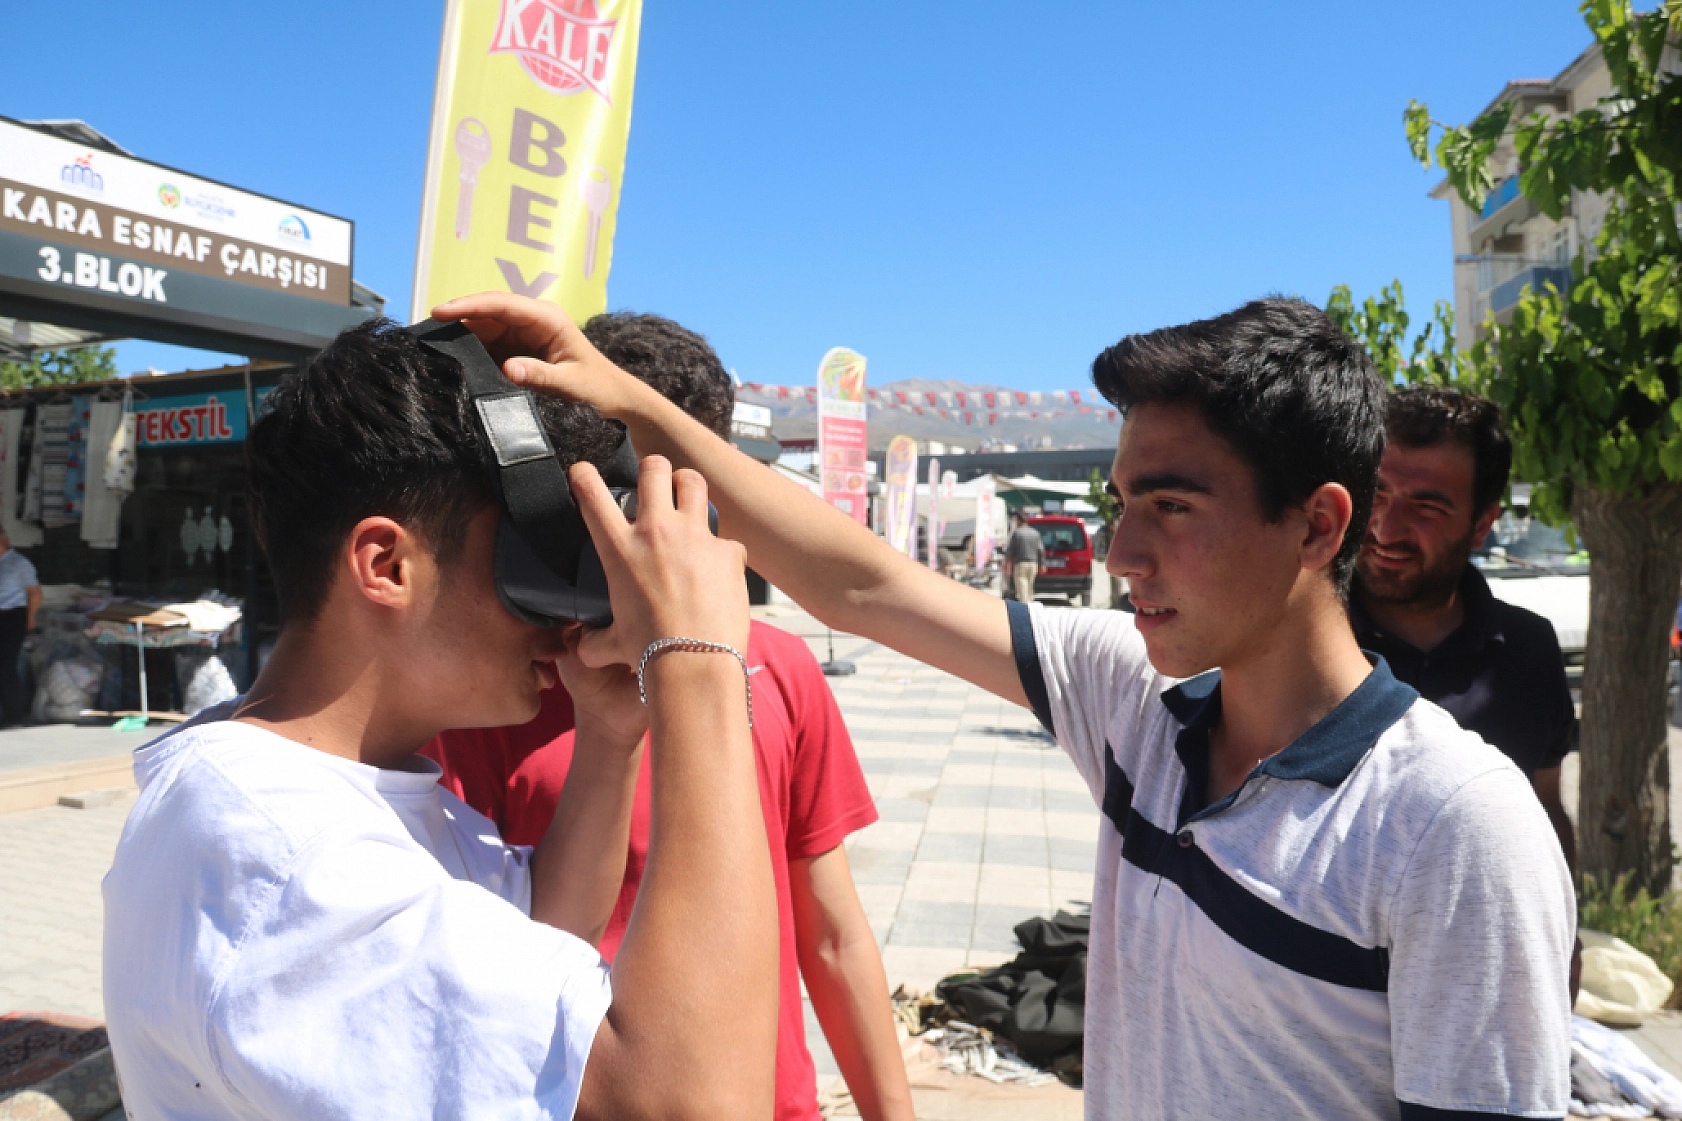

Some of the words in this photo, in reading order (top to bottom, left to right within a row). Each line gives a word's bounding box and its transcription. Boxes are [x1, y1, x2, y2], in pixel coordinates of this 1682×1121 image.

[3, 187, 103, 239] KARA
[113, 215, 213, 262] ESNAF
[221, 243, 328, 290] ÇARŞISI
[37, 247, 167, 302] 3.BLOK
[136, 396, 232, 443] TEKSTİL
